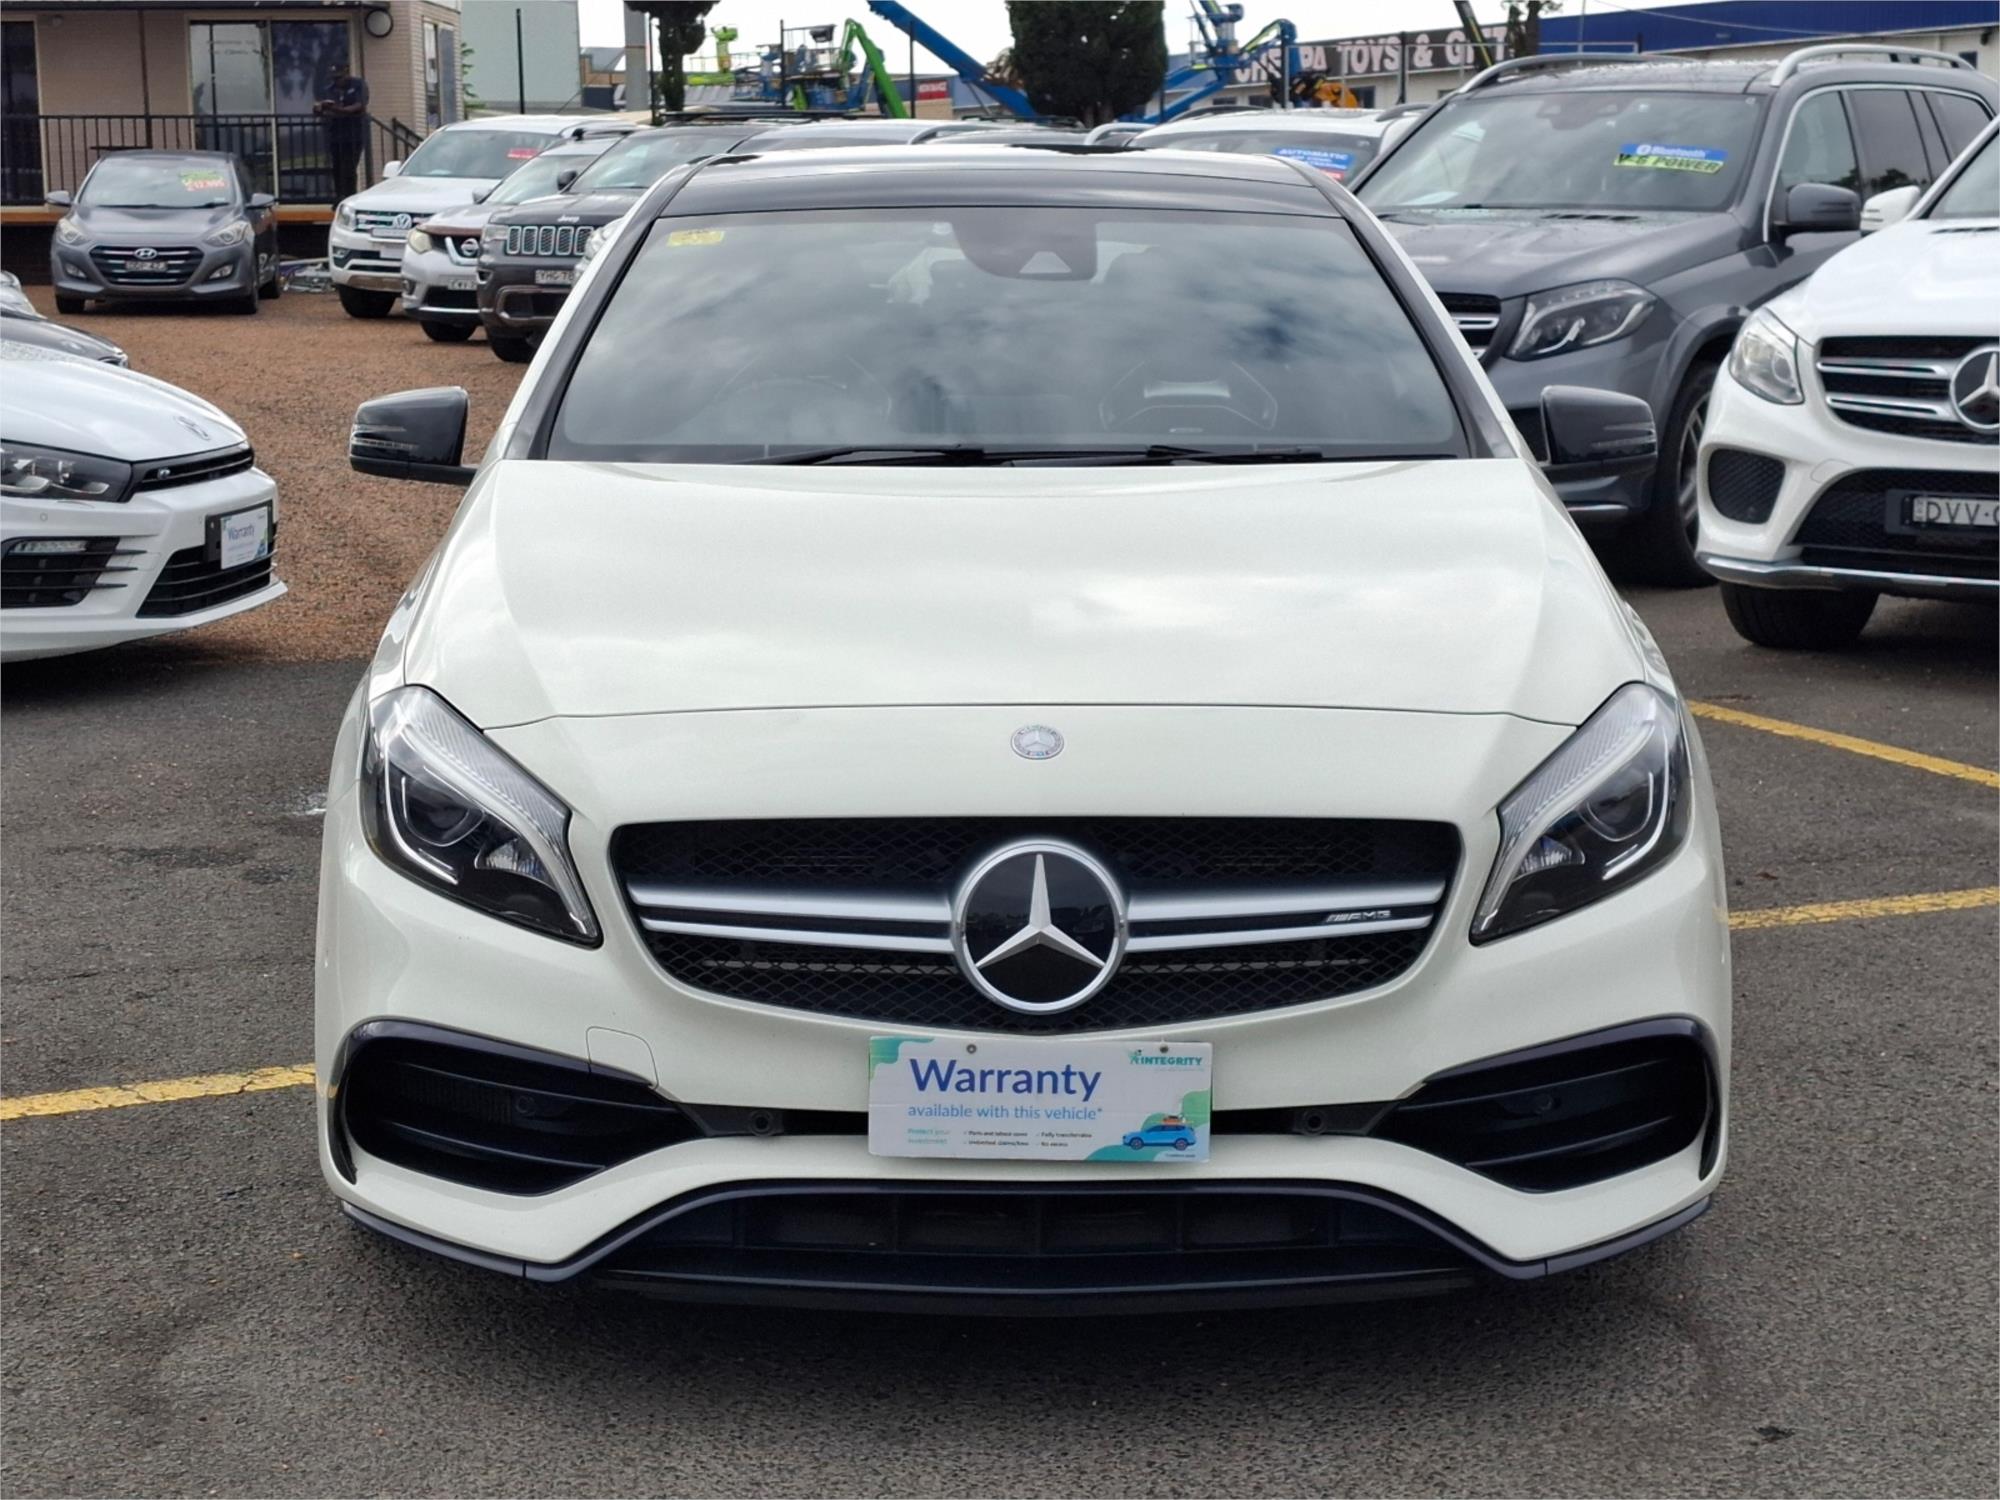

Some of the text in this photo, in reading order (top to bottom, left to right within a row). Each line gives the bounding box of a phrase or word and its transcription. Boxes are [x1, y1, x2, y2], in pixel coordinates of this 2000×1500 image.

[1337, 37, 1400, 76] TOYS
[1413, 34, 1432, 67] &
[1652, 157, 1718, 172] POWER
[1140, 1056, 1203, 1066] INTEGRITY
[909, 1058, 1102, 1102] Warranty
[908, 1104, 973, 1118] available
[977, 1105, 1010, 1119] with
[1014, 1105, 1041, 1120] this
